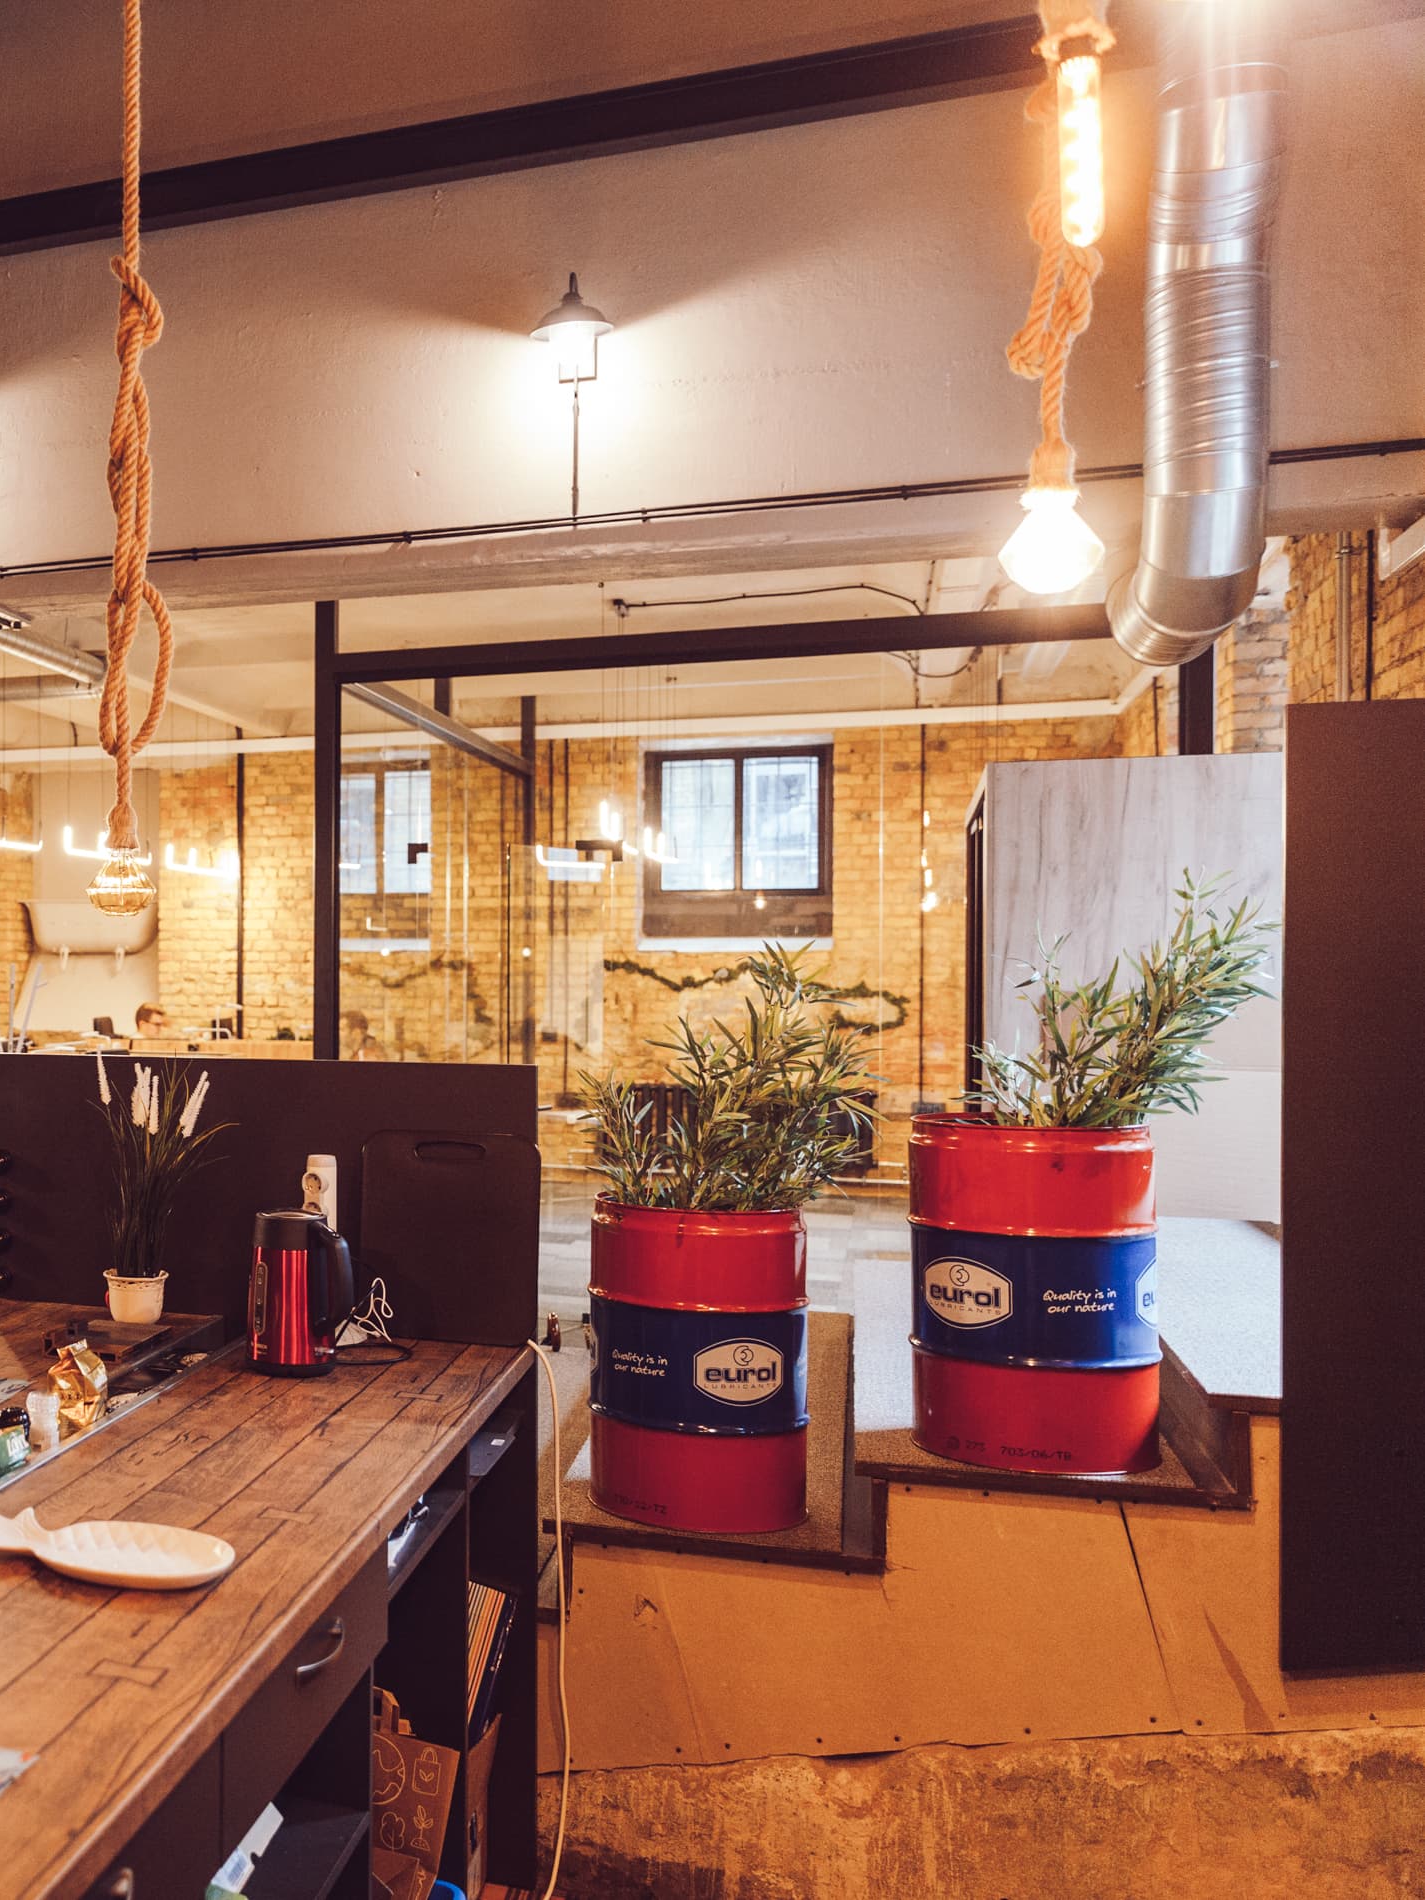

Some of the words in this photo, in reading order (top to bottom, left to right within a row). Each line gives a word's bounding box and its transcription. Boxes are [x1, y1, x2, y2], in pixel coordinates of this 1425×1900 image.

[929, 1284, 1001, 1309] eurol
[1043, 1289, 1091, 1305] Quality
[1095, 1289, 1104, 1299] is
[1107, 1288, 1117, 1298] in
[1047, 1305, 1072, 1314] our
[1075, 1302, 1115, 1313] nature
[612, 1349, 643, 1367] Quality
[646, 1354, 655, 1364] is
[658, 1355, 668, 1366] in
[614, 1363, 628, 1372] our
[631, 1365, 666, 1377] nature
[704, 1361, 777, 1383] eurol
